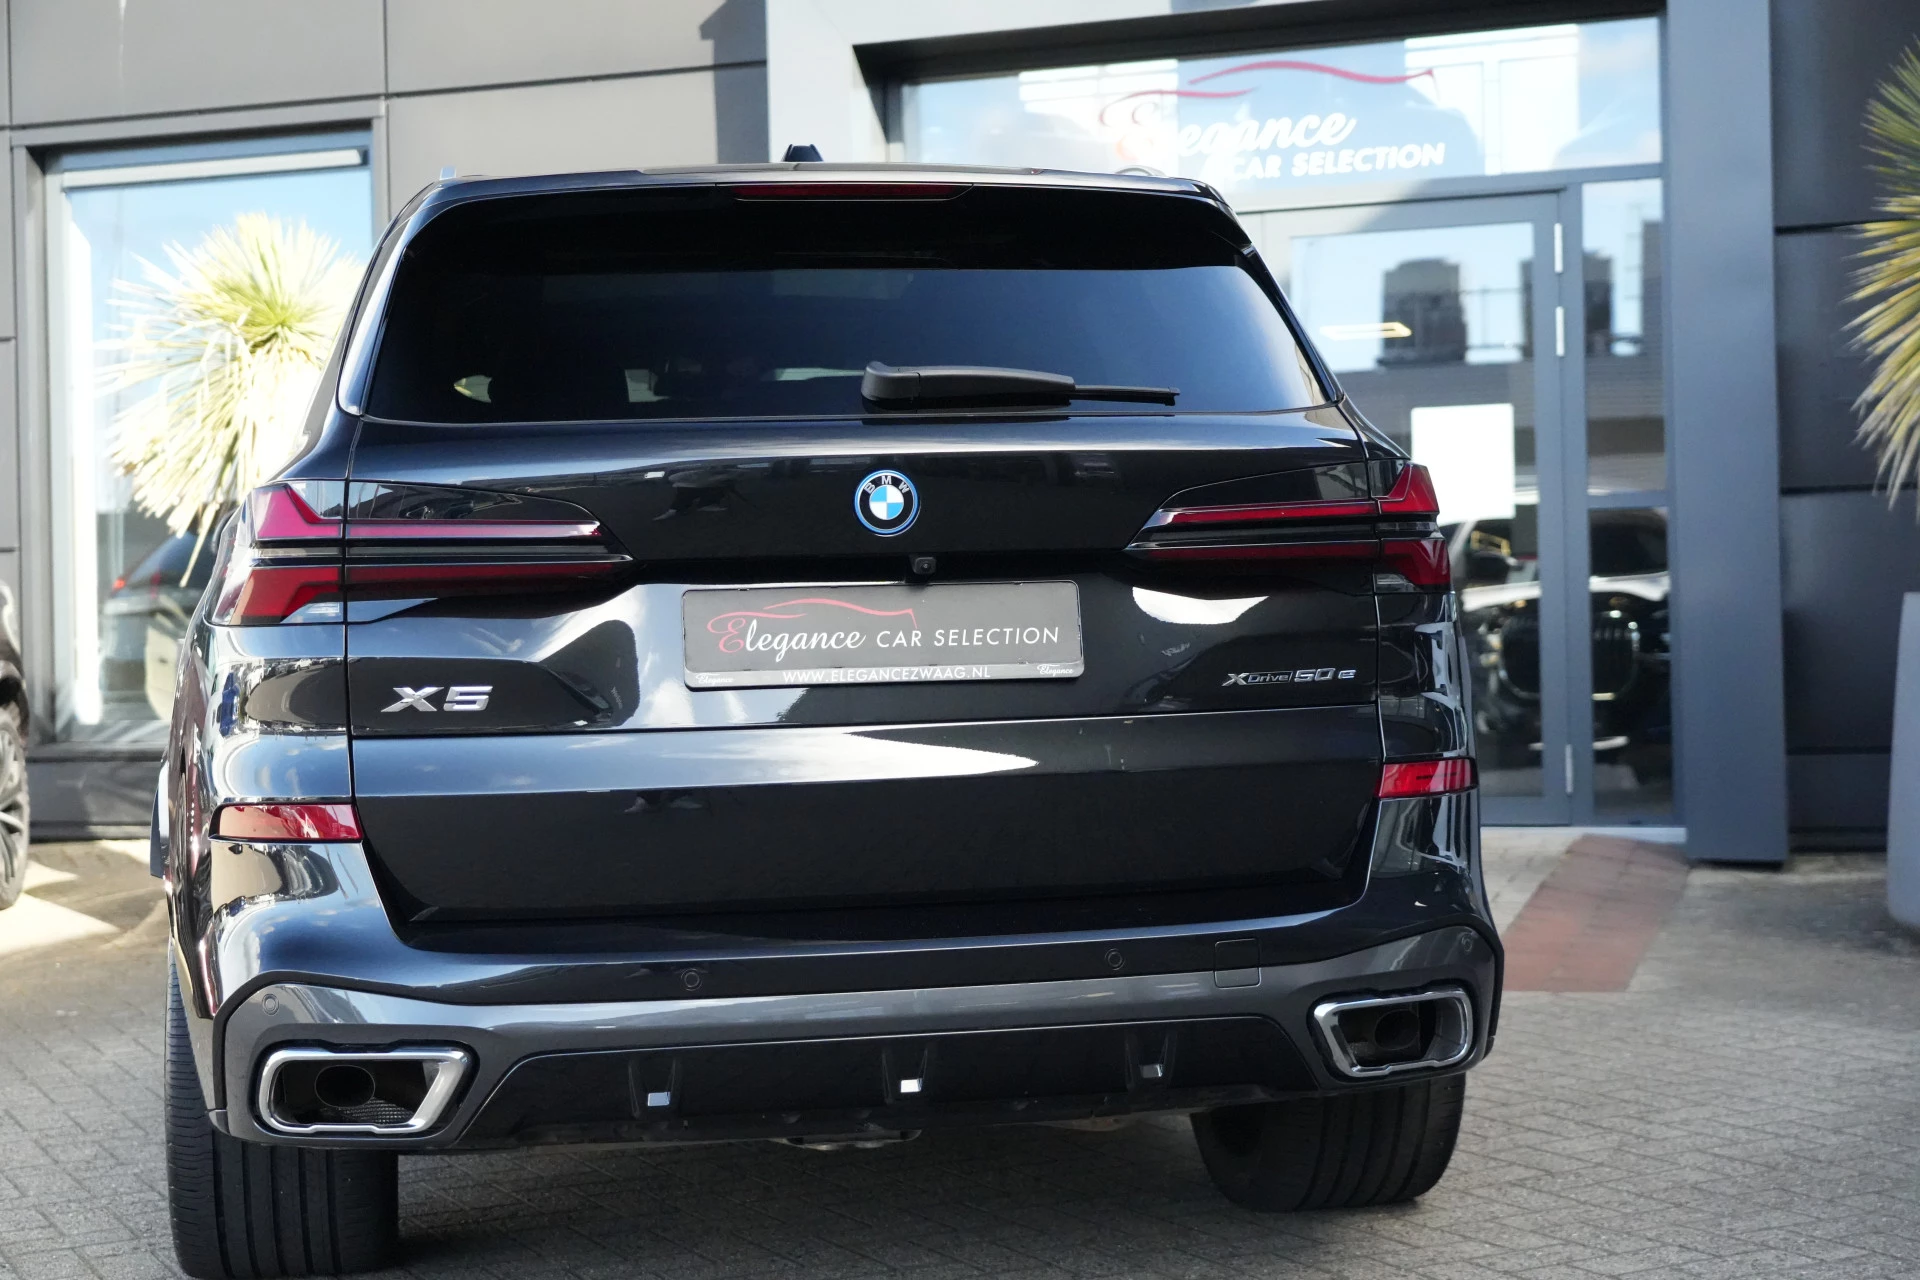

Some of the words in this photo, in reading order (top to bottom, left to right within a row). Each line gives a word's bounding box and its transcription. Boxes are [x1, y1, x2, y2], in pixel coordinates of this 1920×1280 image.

[1233, 154, 1281, 180] CAR
[1291, 142, 1445, 177] SELECTION
[863, 475, 910, 494] BMW
[717, 618, 866, 662] Elegance
[876, 629, 922, 648] CAR
[933, 626, 1060, 647] SELECTION
[782, 665, 991, 683] WWW.ELEGANCEZWAAG.NL
[1037, 664, 1074, 677] Elegance
[380, 686, 493, 712] X5
